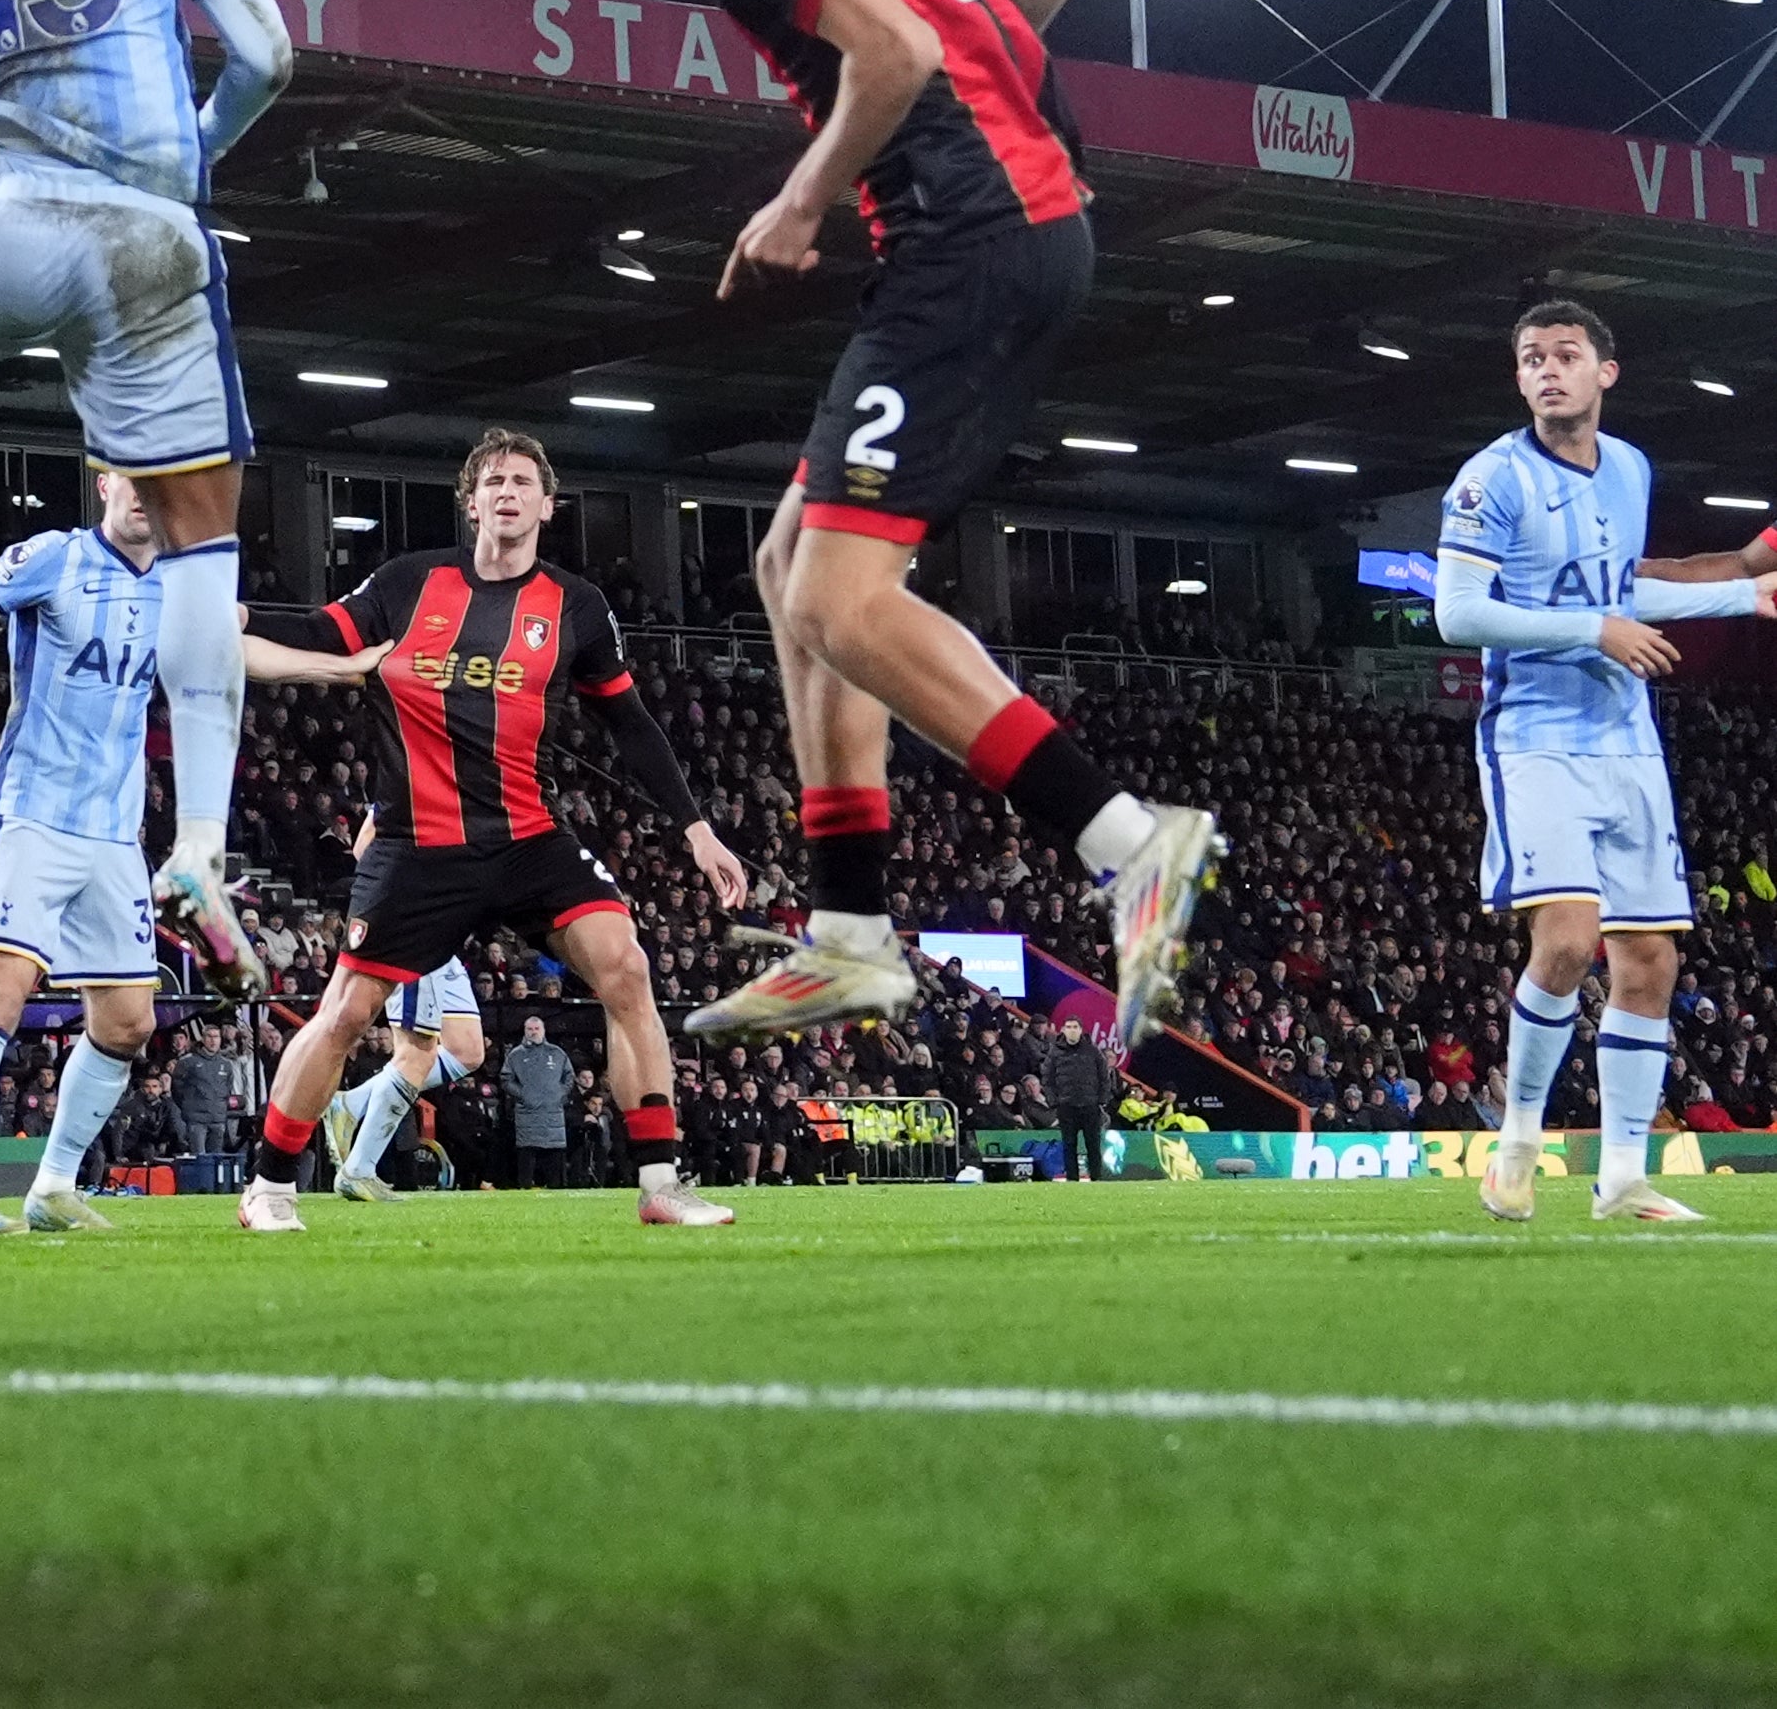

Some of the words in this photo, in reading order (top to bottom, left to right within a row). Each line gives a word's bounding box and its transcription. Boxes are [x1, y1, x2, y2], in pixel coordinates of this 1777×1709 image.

[1258, 92, 1349, 177] Vitality
[1626, 141, 1764, 227] VIT
[844, 384, 905, 471] 2
[414, 651, 525, 693] bj88
